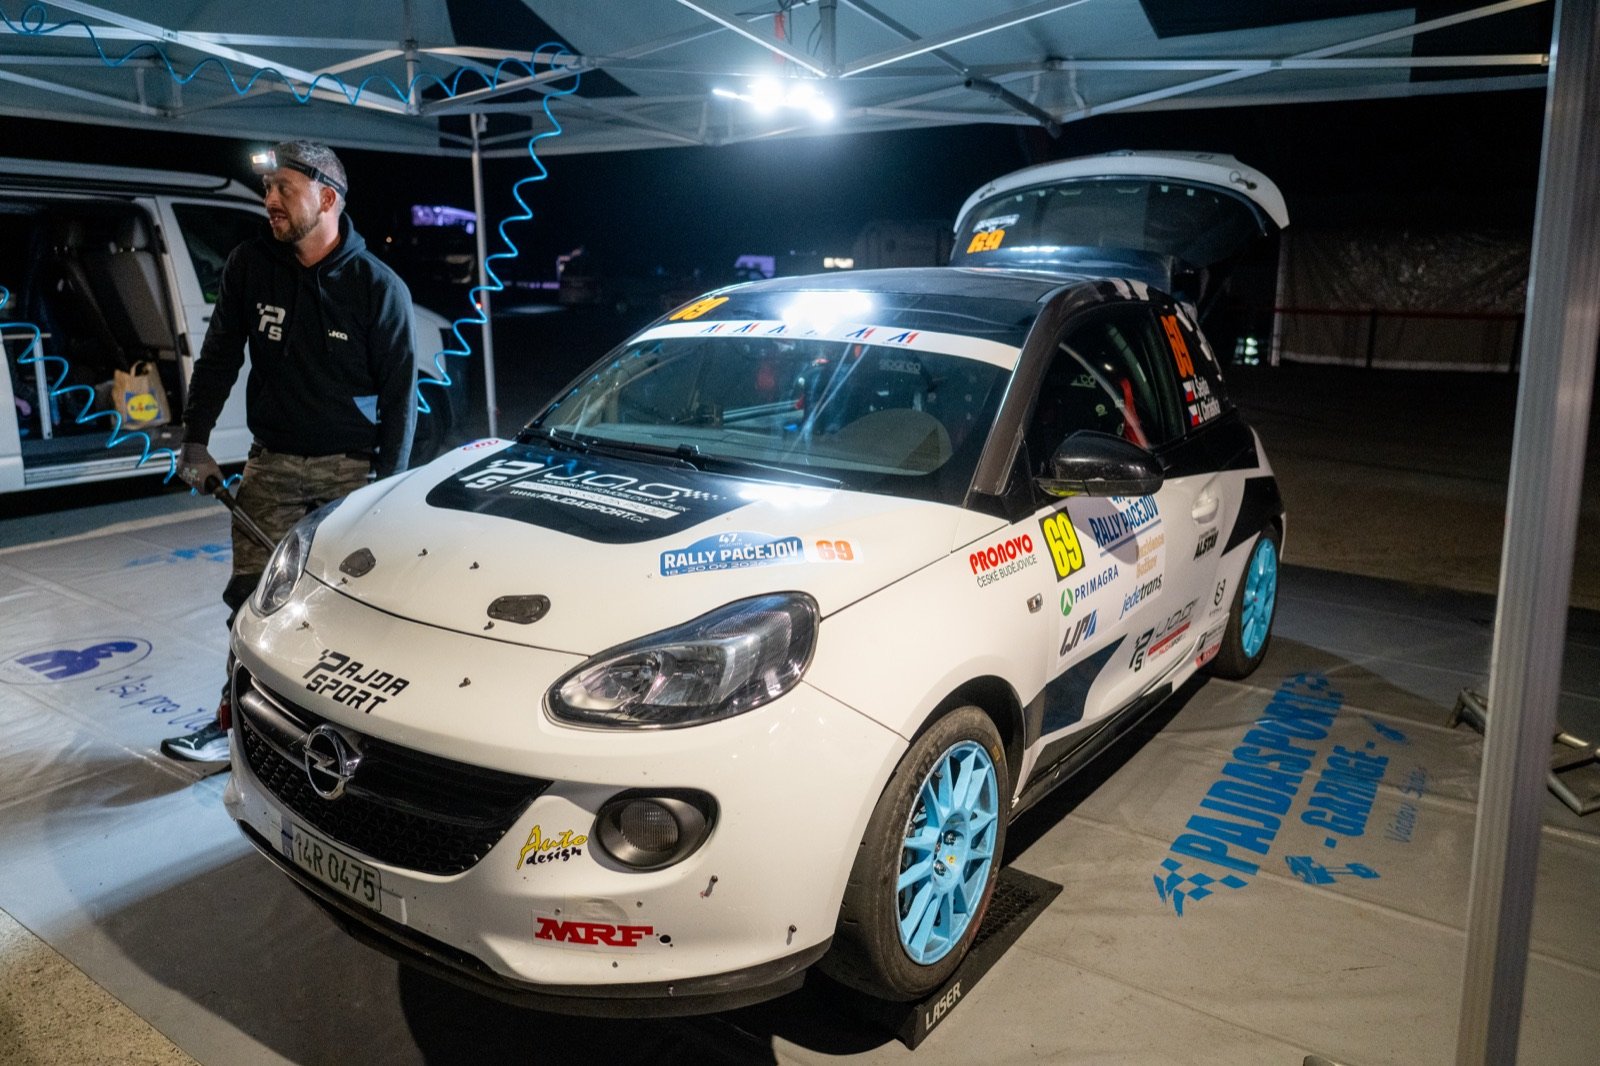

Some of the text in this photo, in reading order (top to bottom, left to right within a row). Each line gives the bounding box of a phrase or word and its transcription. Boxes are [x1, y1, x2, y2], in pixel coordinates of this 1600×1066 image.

[815, 540, 855, 561] 69
[1043, 512, 1084, 578] 69
[1088, 513, 1123, 549] RALLY
[664, 540, 799, 570] RALLY PAČEJOV
[969, 533, 1033, 576] PRONOVO
[977, 554, 1038, 589] ČESKÉ BUDĚJOVICE
[1074, 564, 1119, 604] PRIMAGRA
[302, 649, 410, 697] PAJDA
[305, 673, 388, 715] SPORT
[294, 832, 376, 903] 14R 0475
[516, 825, 588, 872] Auto
[526, 847, 582, 866] design
[534, 917, 654, 948] MRF
[925, 981, 961, 1031] LASER
